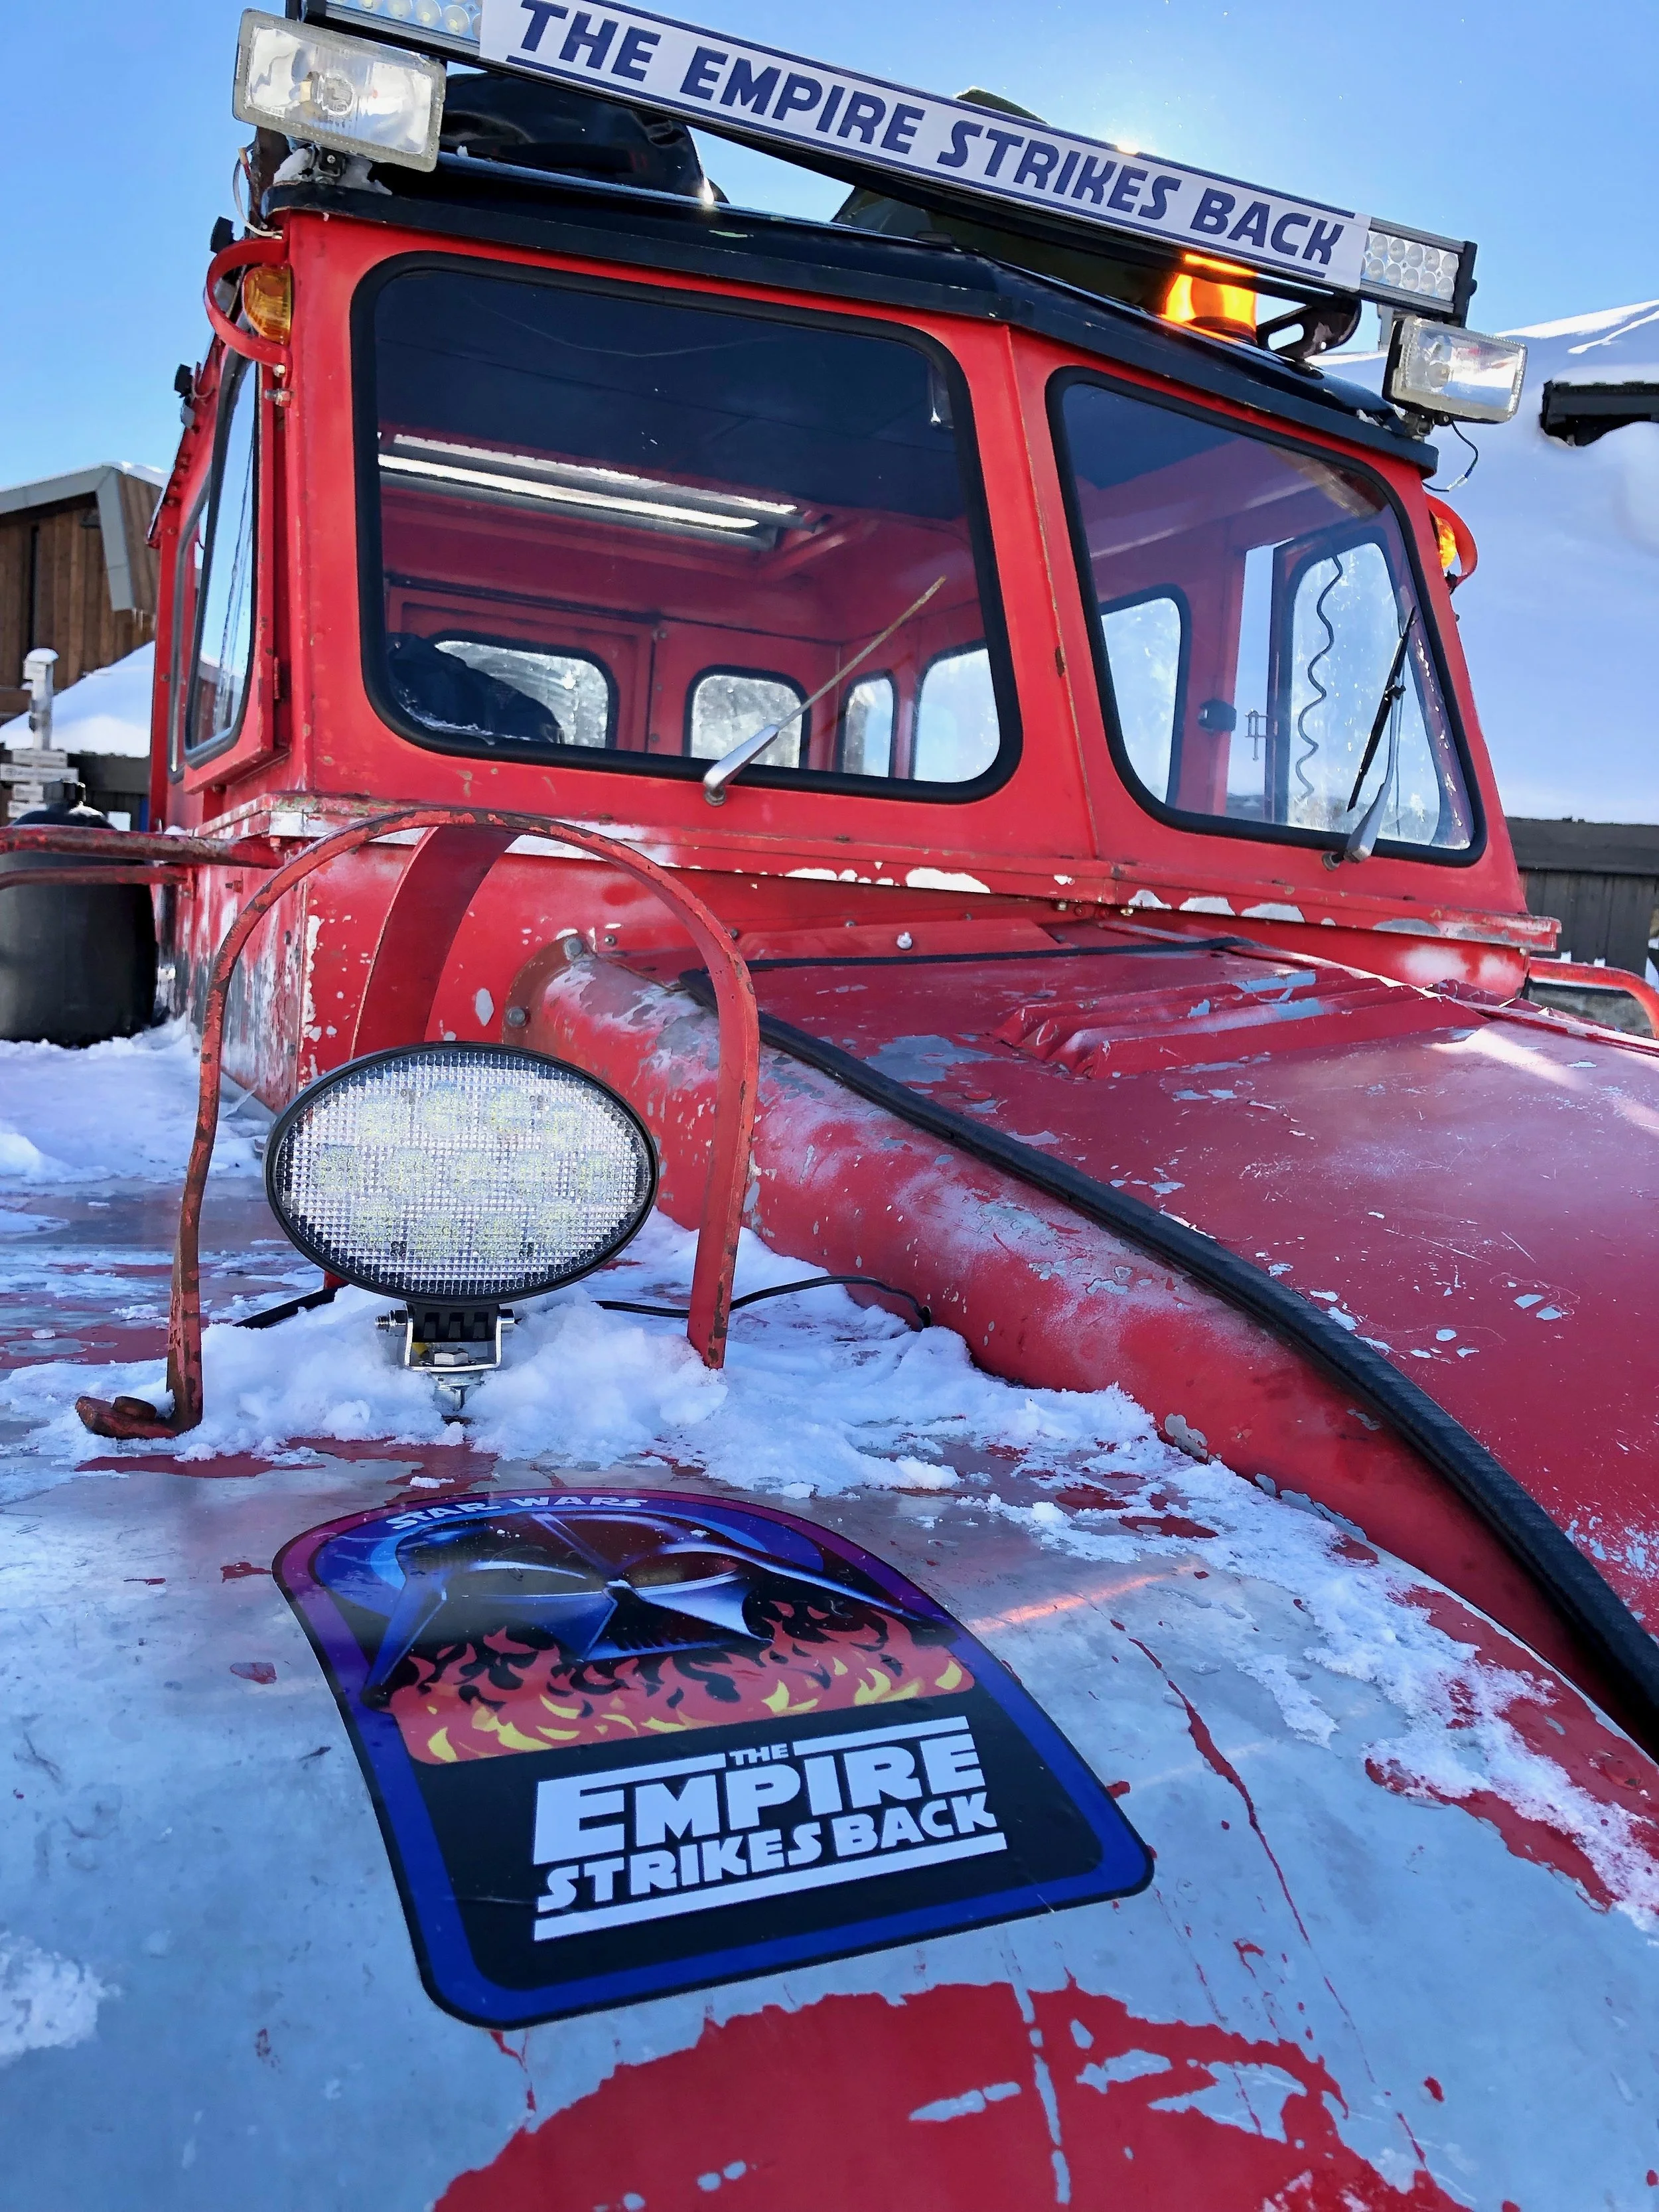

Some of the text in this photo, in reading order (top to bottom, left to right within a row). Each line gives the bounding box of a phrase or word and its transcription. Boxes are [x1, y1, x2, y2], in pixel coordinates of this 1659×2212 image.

[520, 0, 1344, 265] THE EMPIRE STRIKES BACK
[386, 1497, 649, 1530] STAR WARS
[533, 1733, 986, 1865] EMPIRE
[729, 1743, 790, 1766] THE
[537, 1791, 997, 1913] STRIKES BACK
